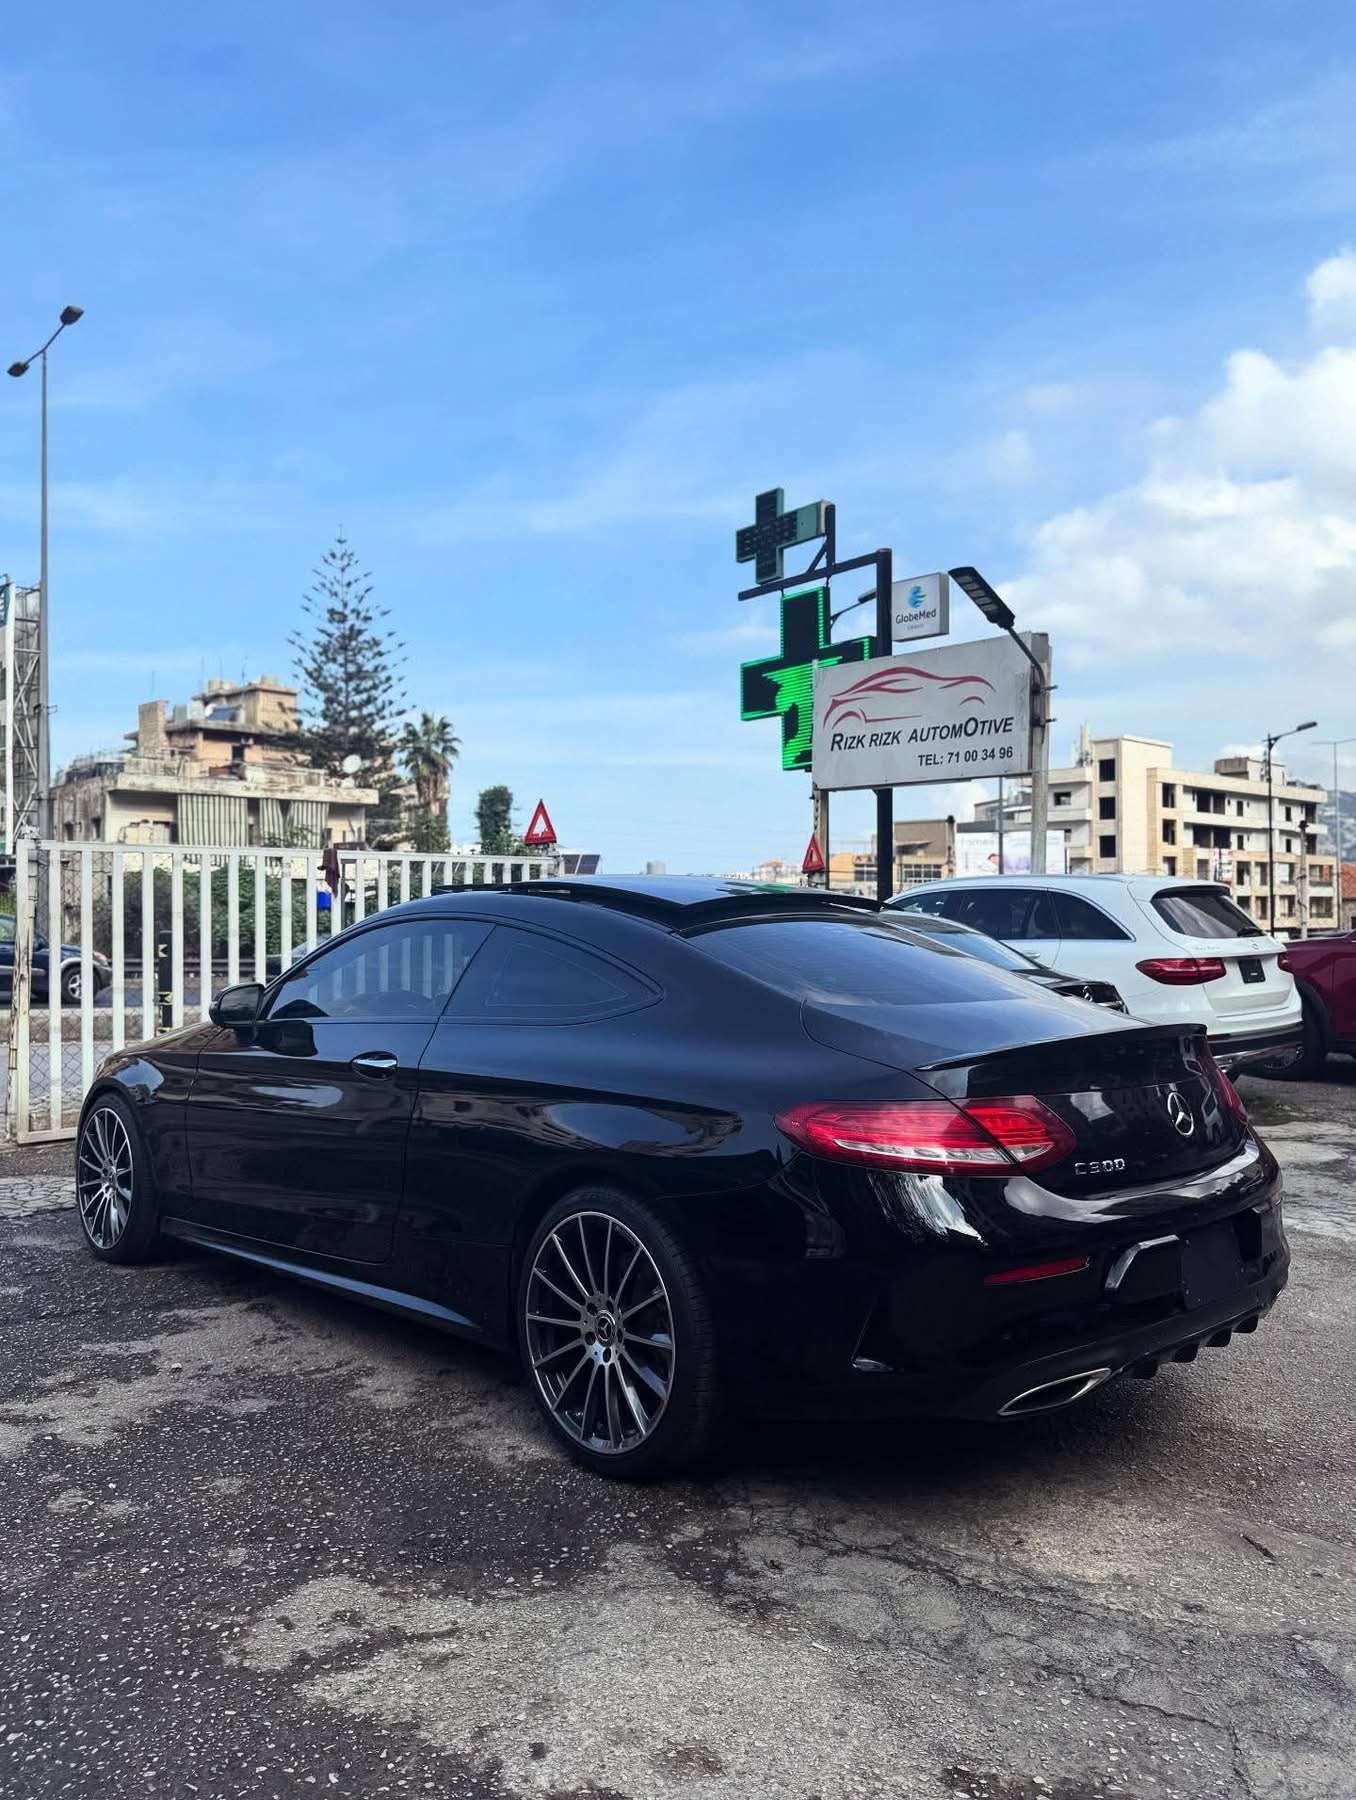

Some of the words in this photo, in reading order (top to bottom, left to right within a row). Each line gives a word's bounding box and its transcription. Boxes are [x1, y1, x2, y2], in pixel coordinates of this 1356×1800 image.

[895, 608, 937, 624] GlobeMed
[830, 733, 866, 752] RIZK
[868, 730, 903, 748] RIZK
[907, 717, 1014, 743] AUTOMOTIVE
[918, 754, 943, 767] TEL:
[947, 751, 960, 764] 71
[964, 749, 978, 763] 00
[981, 747, 995, 761] 34
[998, 746, 1013, 760] 96
[1074, 1158, 1125, 1175] C300
